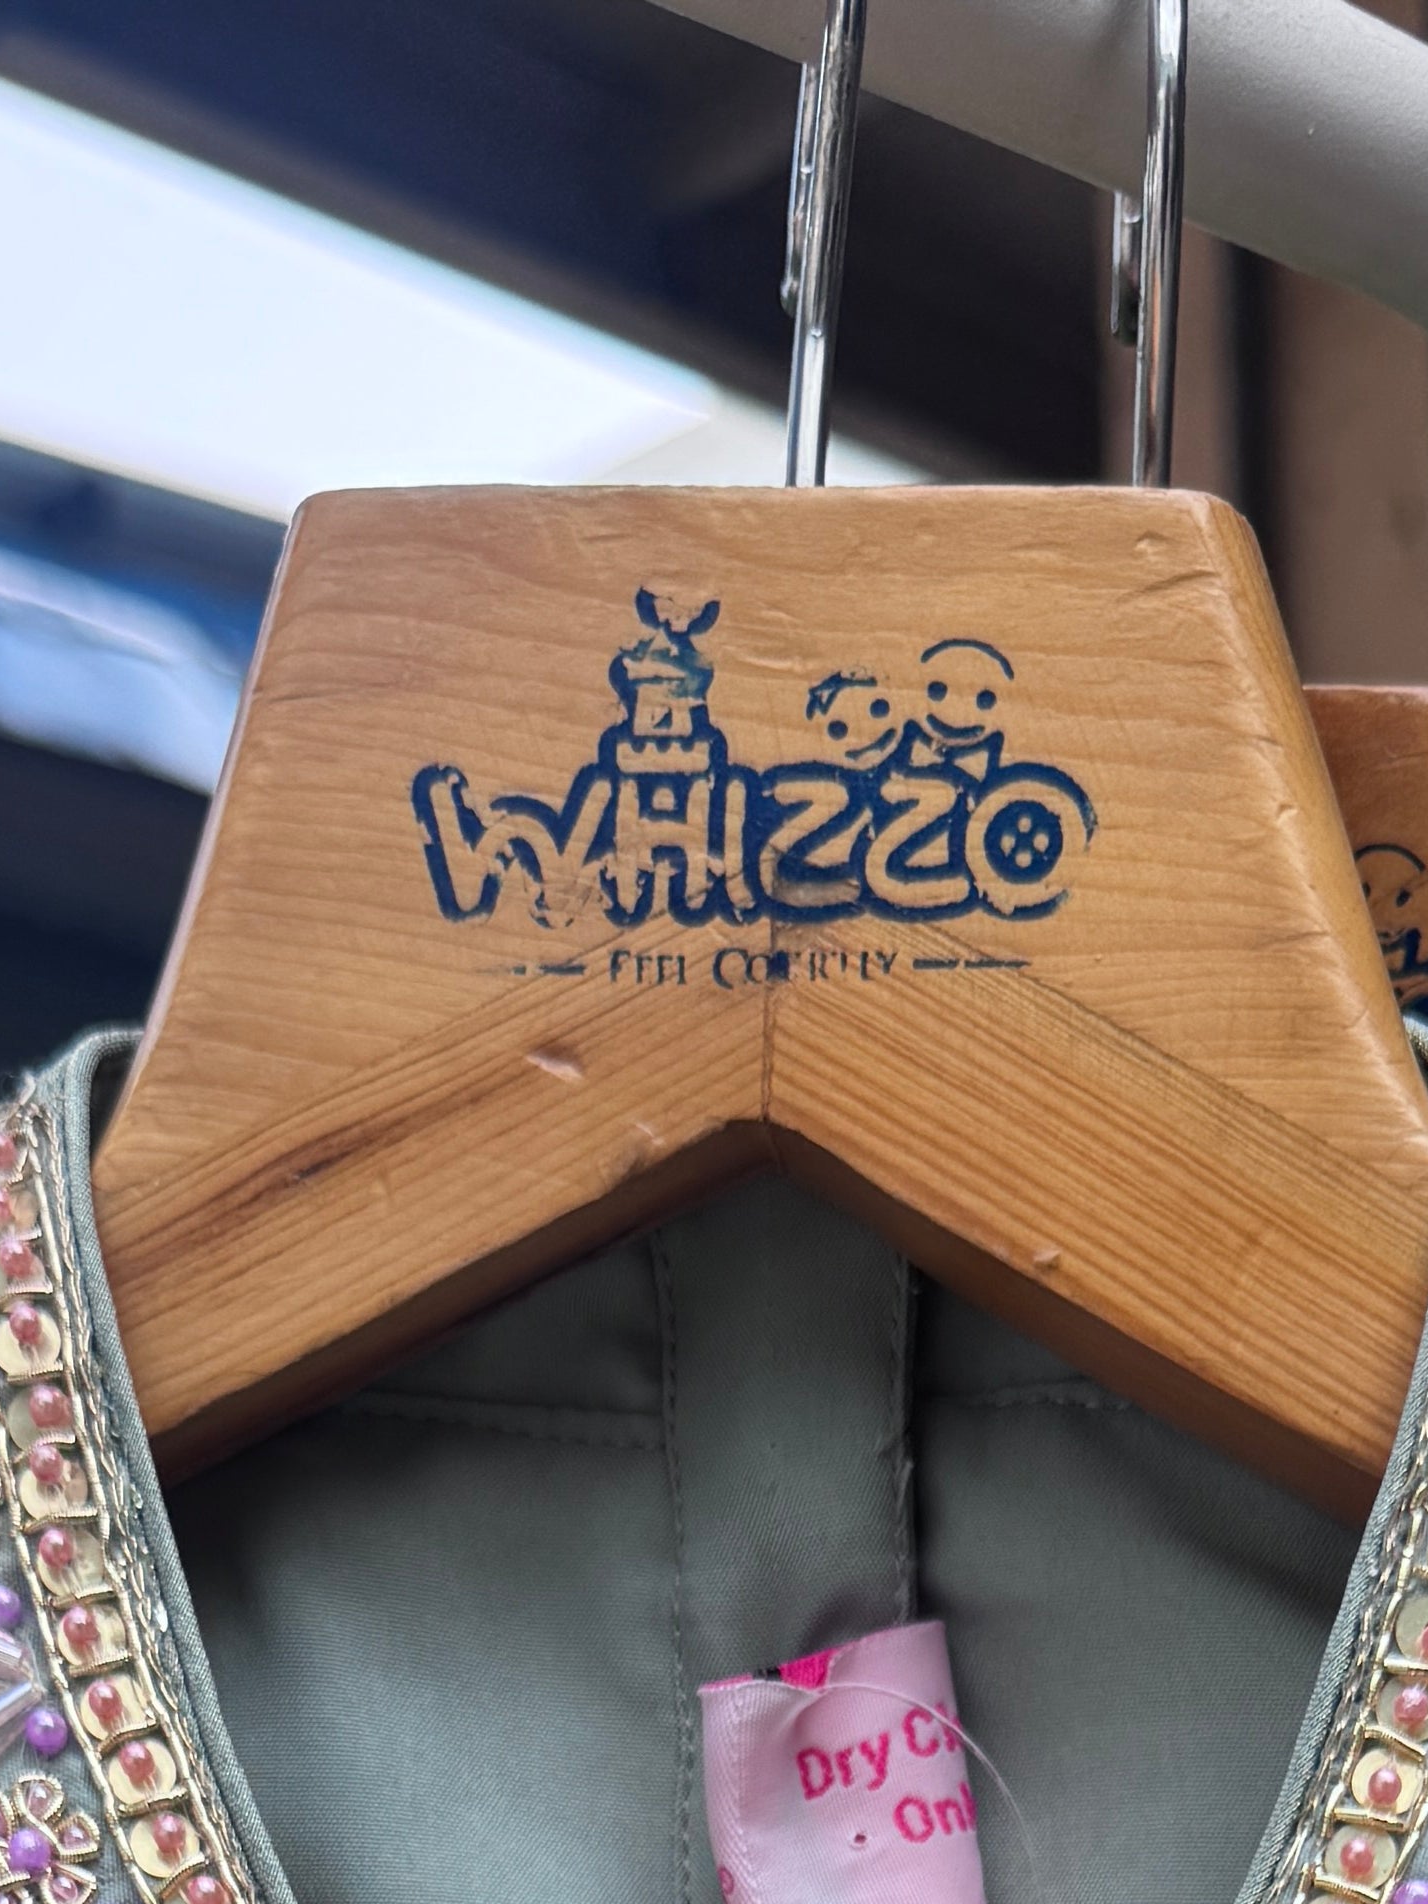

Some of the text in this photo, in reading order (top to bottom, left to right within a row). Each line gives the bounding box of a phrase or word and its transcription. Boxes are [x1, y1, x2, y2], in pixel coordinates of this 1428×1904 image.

[410, 760, 1099, 930] WHIZZO
[796, 1731, 890, 1801] Dry
[893, 1780, 978, 1844] Onl
